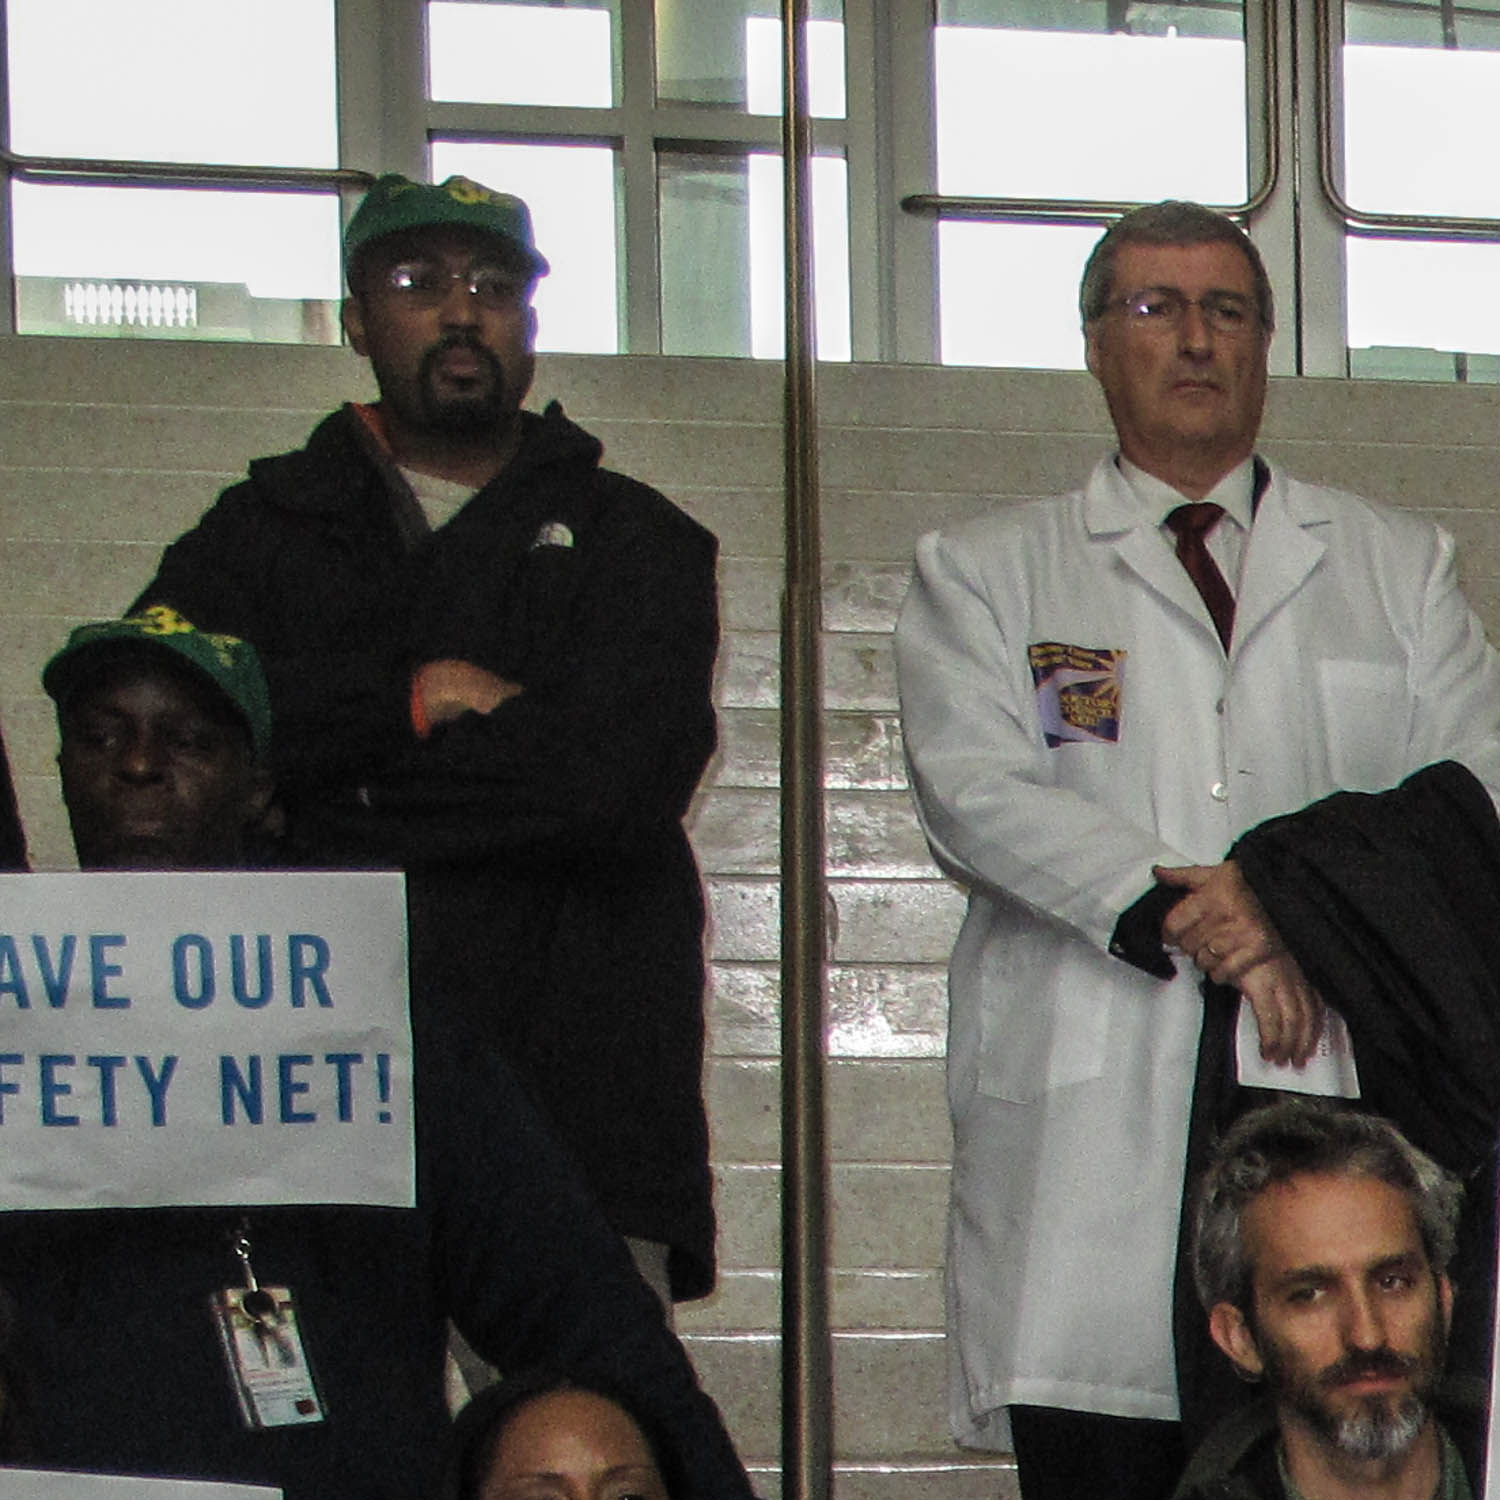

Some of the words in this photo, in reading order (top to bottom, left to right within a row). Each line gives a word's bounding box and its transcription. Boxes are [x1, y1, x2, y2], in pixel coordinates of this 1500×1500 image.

[0, 934, 131, 1011] AVE
[172, 933, 334, 1011] OUR
[0, 1053, 179, 1128] FETY
[220, 1053, 392, 1126] NET!
